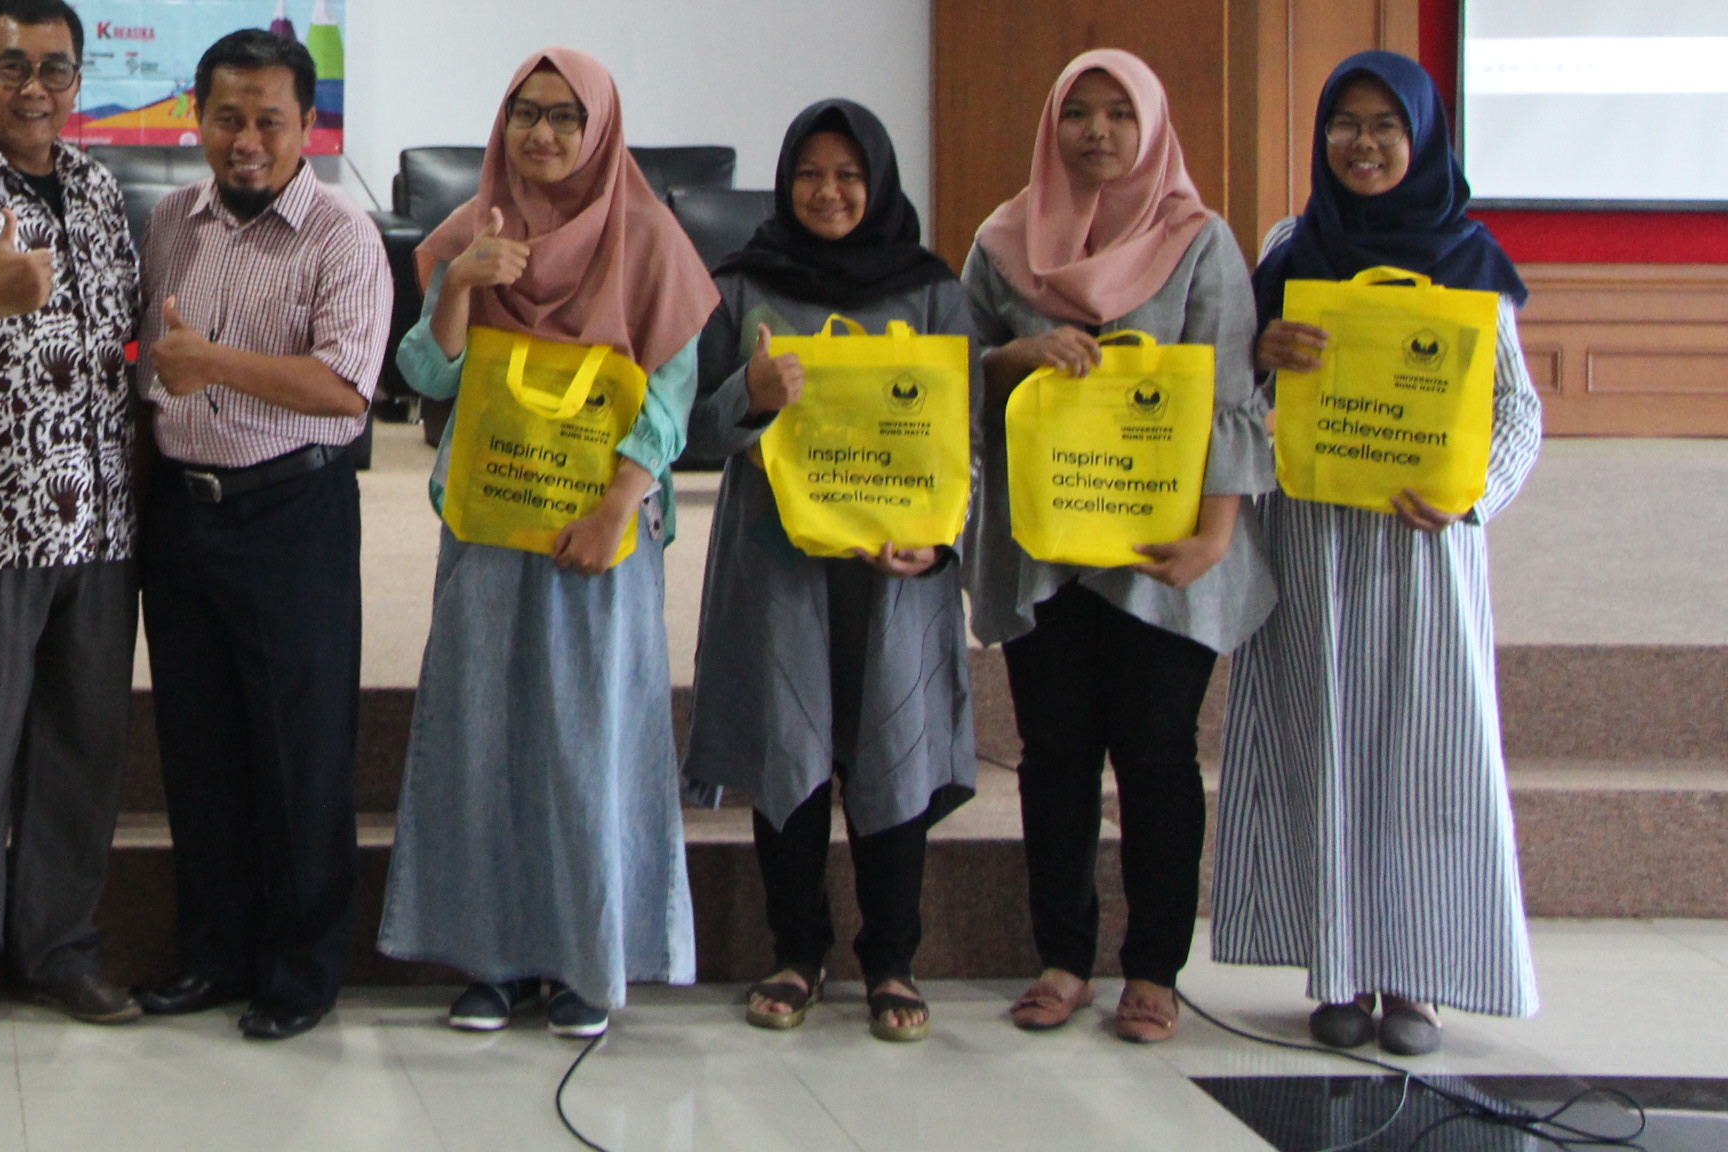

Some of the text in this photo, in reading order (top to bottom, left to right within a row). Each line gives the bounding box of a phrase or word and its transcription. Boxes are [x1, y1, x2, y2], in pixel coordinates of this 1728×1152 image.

[1321, 393, 1404, 421] inspiring
[1317, 416, 1448, 446] achievement
[490, 434, 568, 468] inspiring
[808, 445, 892, 466] inspiring
[1052, 448, 1134, 471] inspiring
[1314, 440, 1421, 467] excellence
[486, 459, 607, 496] achievement
[808, 469, 935, 489] achievement
[1052, 471, 1178, 492] achievement
[483, 484, 578, 514] excellence
[809, 490, 912, 508] excellence
[1052, 496, 1154, 516] excellence
